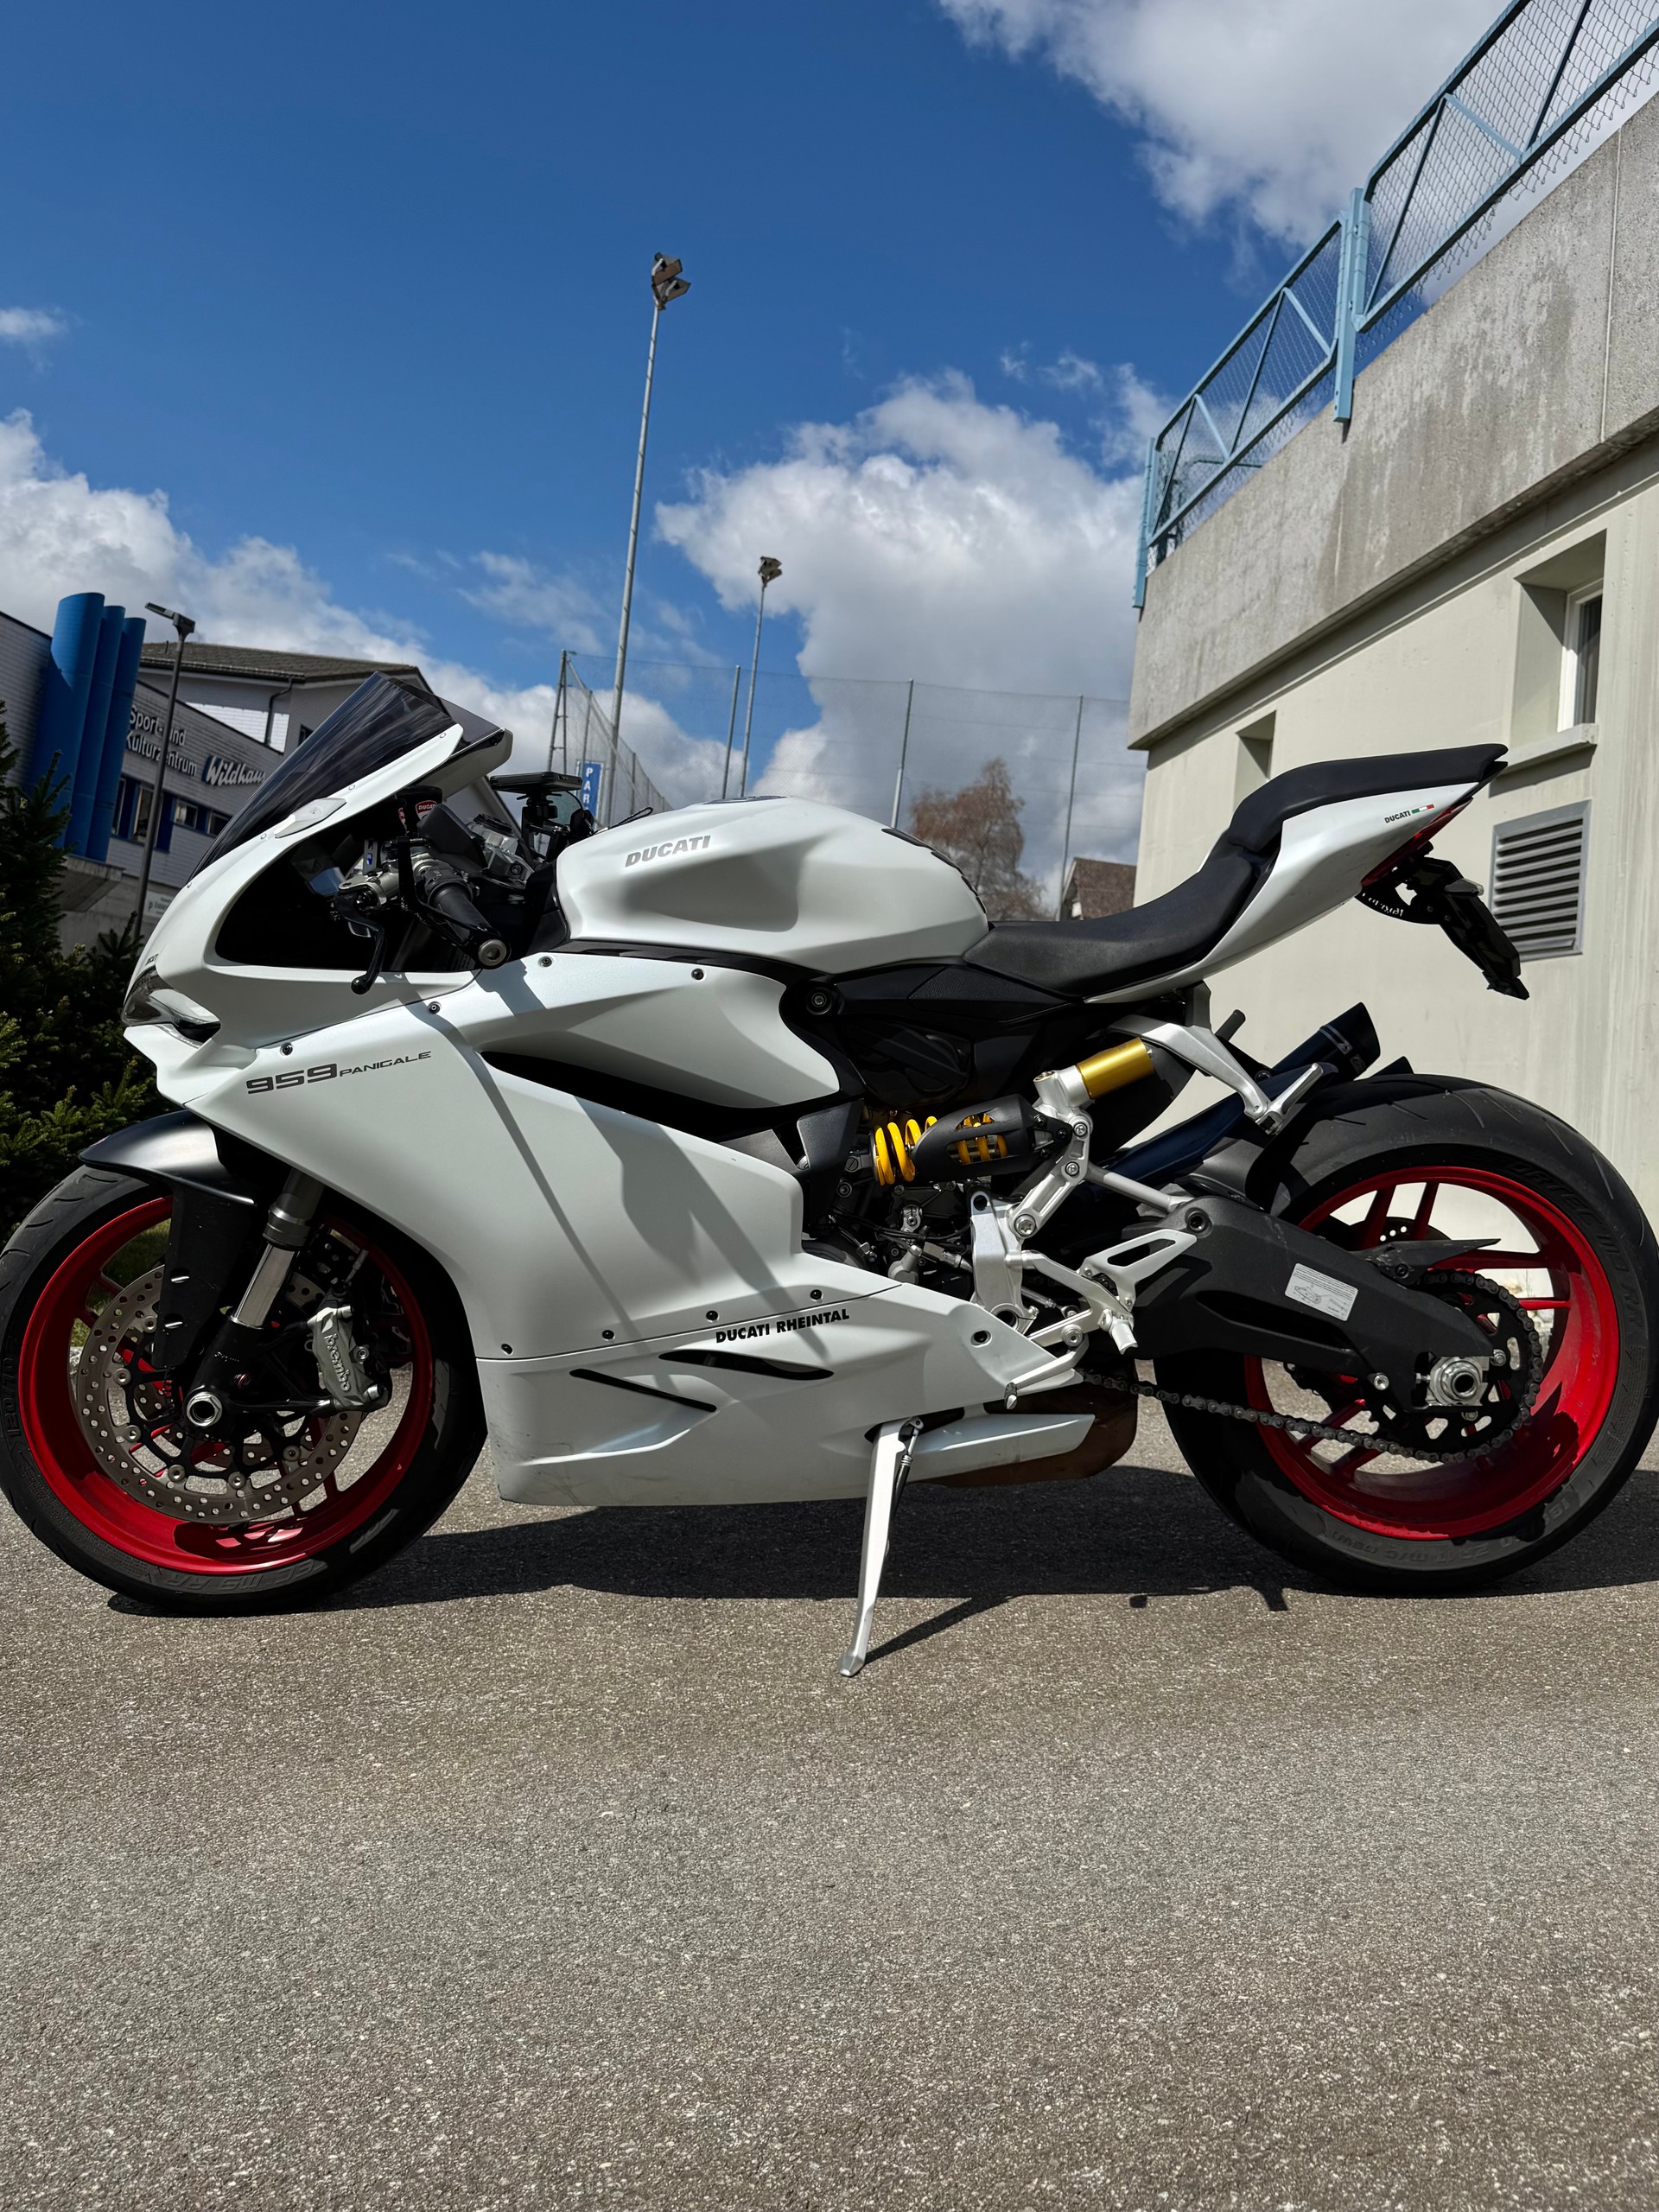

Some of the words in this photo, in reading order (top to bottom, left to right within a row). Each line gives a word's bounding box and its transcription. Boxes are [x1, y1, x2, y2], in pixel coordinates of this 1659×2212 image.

[130, 704, 163, 735] Sport-
[126, 730, 198, 777] Kulturzntrum
[582, 767, 594, 810] PAR
[1384, 810, 1411, 823] DUCATI
[625, 835, 711, 868] DUCATI
[246, 1064, 337, 1094] 959
[339, 1051, 431, 1077] PANIGALE
[715, 1323, 770, 1344] DUCATI
[776, 1308, 849, 1333] RHEINTAL
[324, 1333, 350, 1391] brembo
